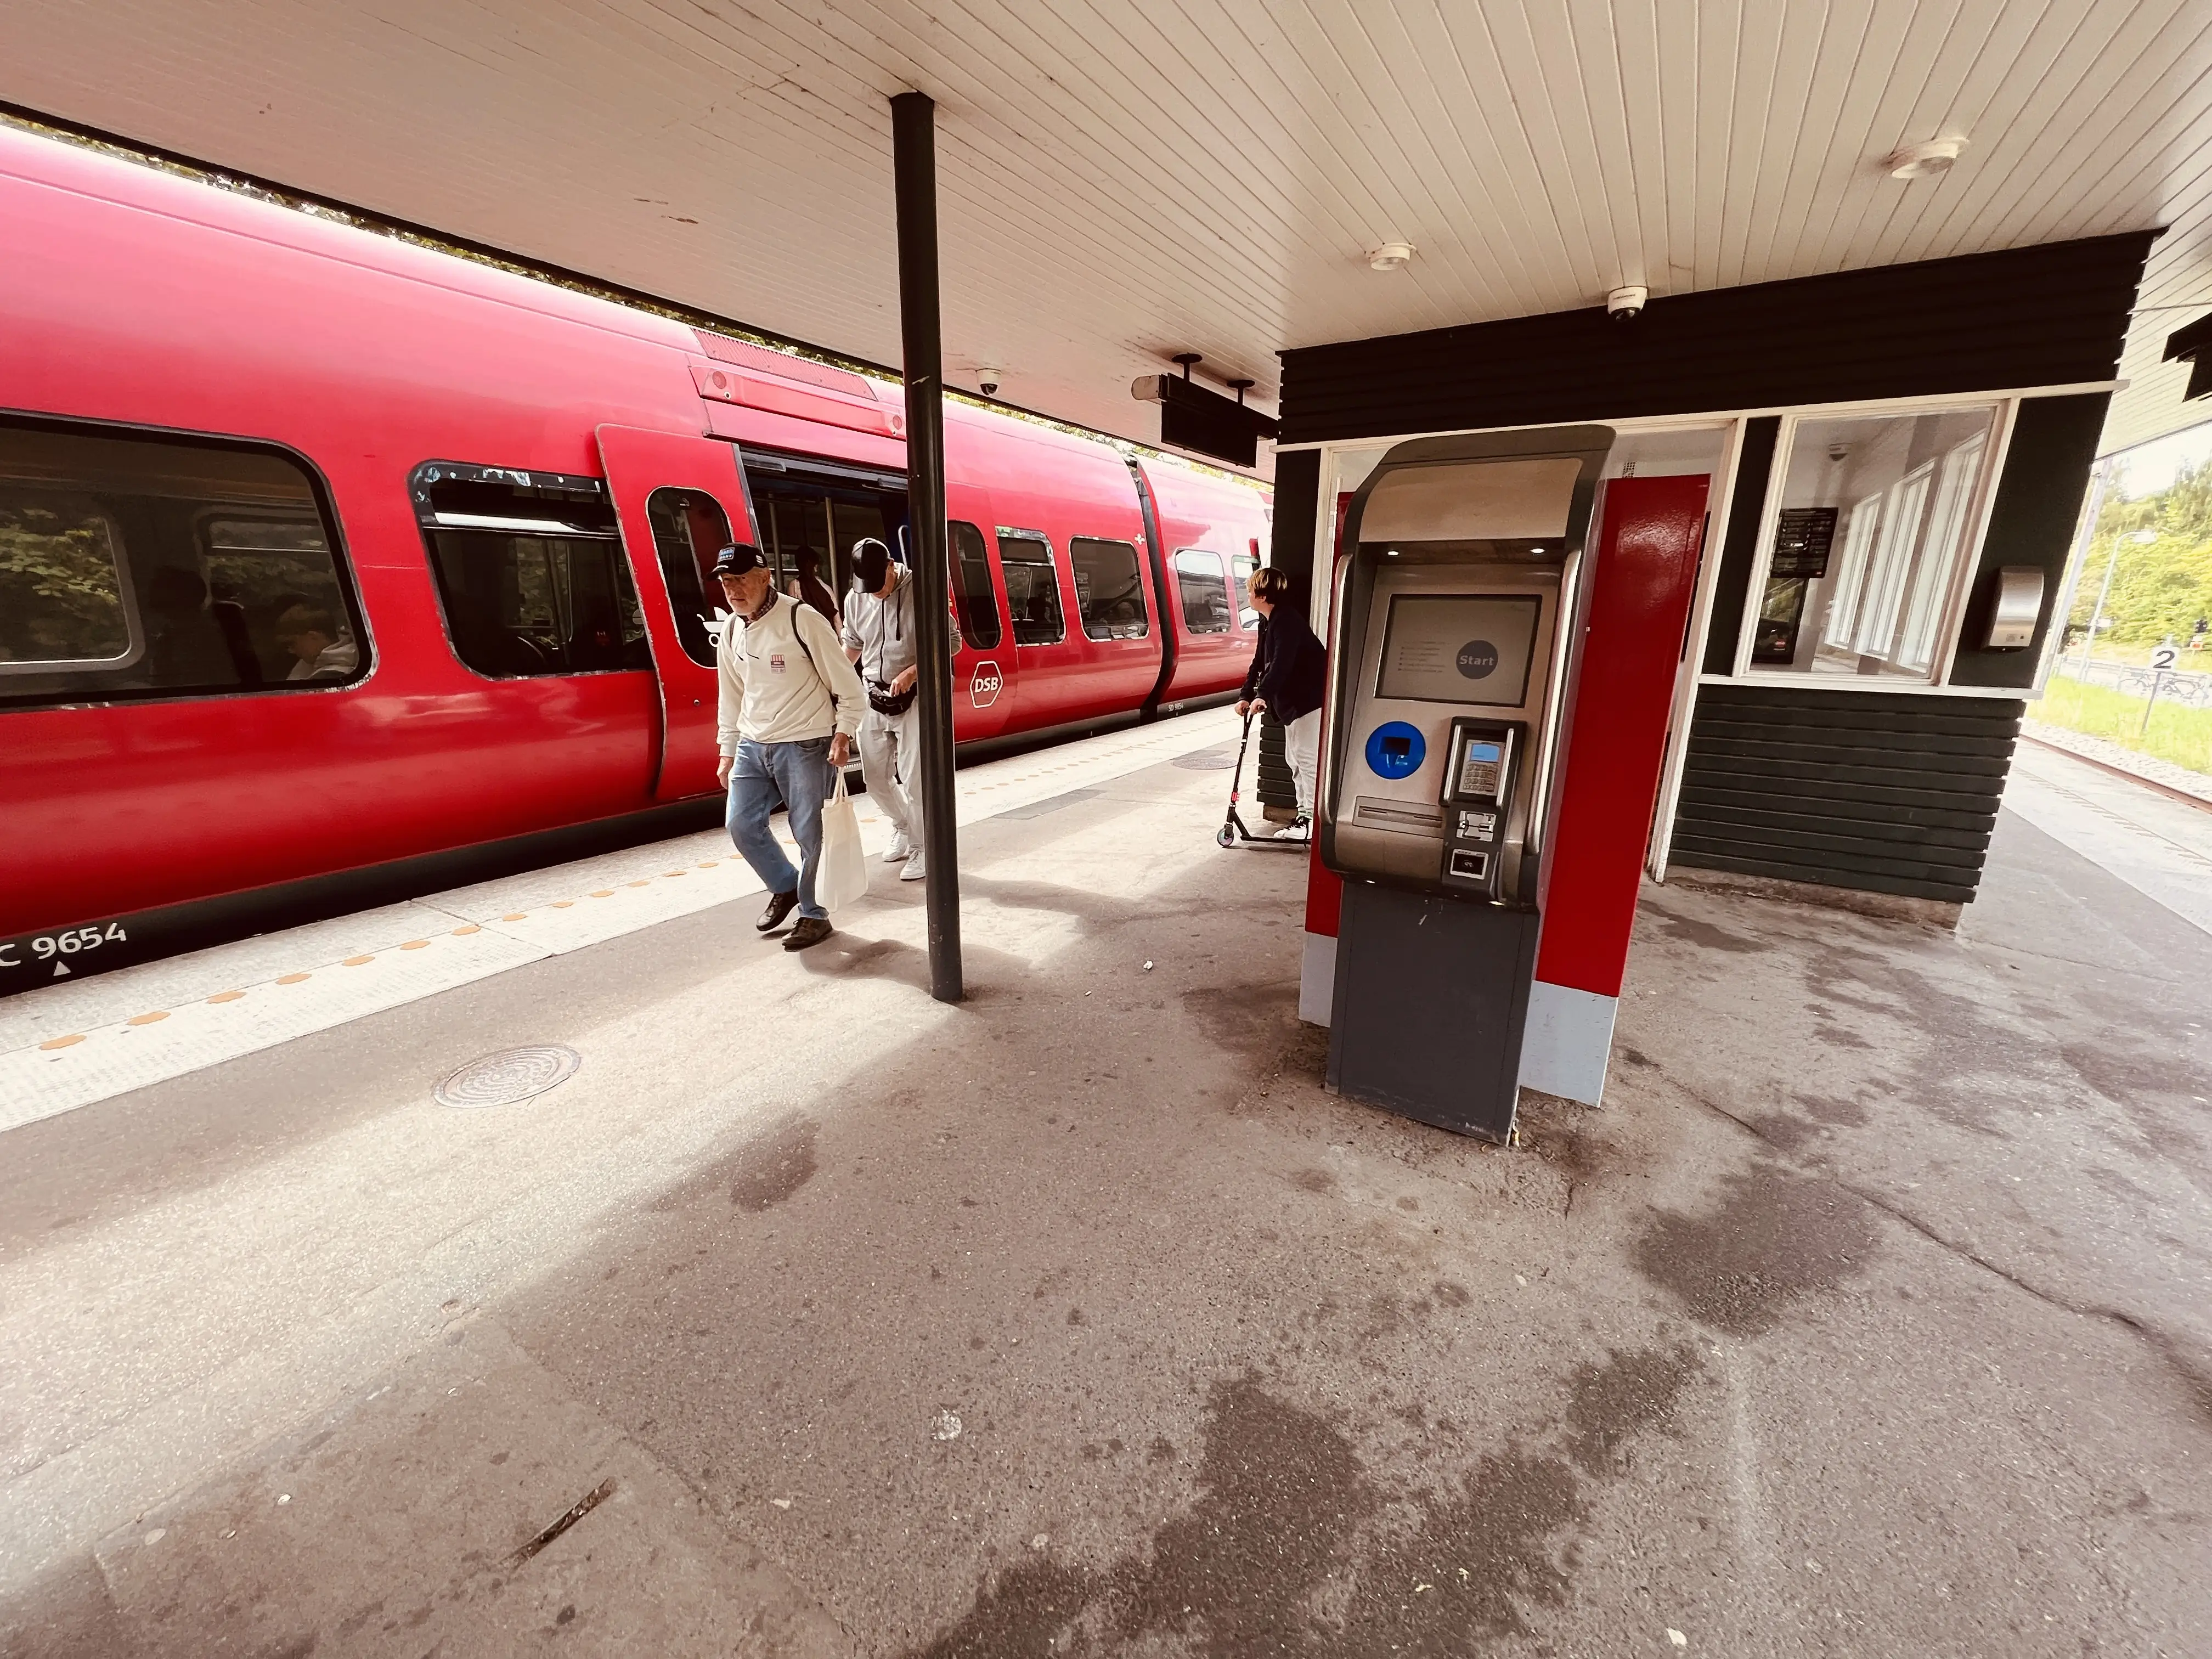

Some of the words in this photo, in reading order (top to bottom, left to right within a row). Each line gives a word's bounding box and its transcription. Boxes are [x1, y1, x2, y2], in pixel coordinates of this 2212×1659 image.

[1459, 655, 1494, 665] Start
[2153, 650, 2175, 669] 2
[974, 676, 998, 692] DSB
[31, 922, 127, 960] 9654
